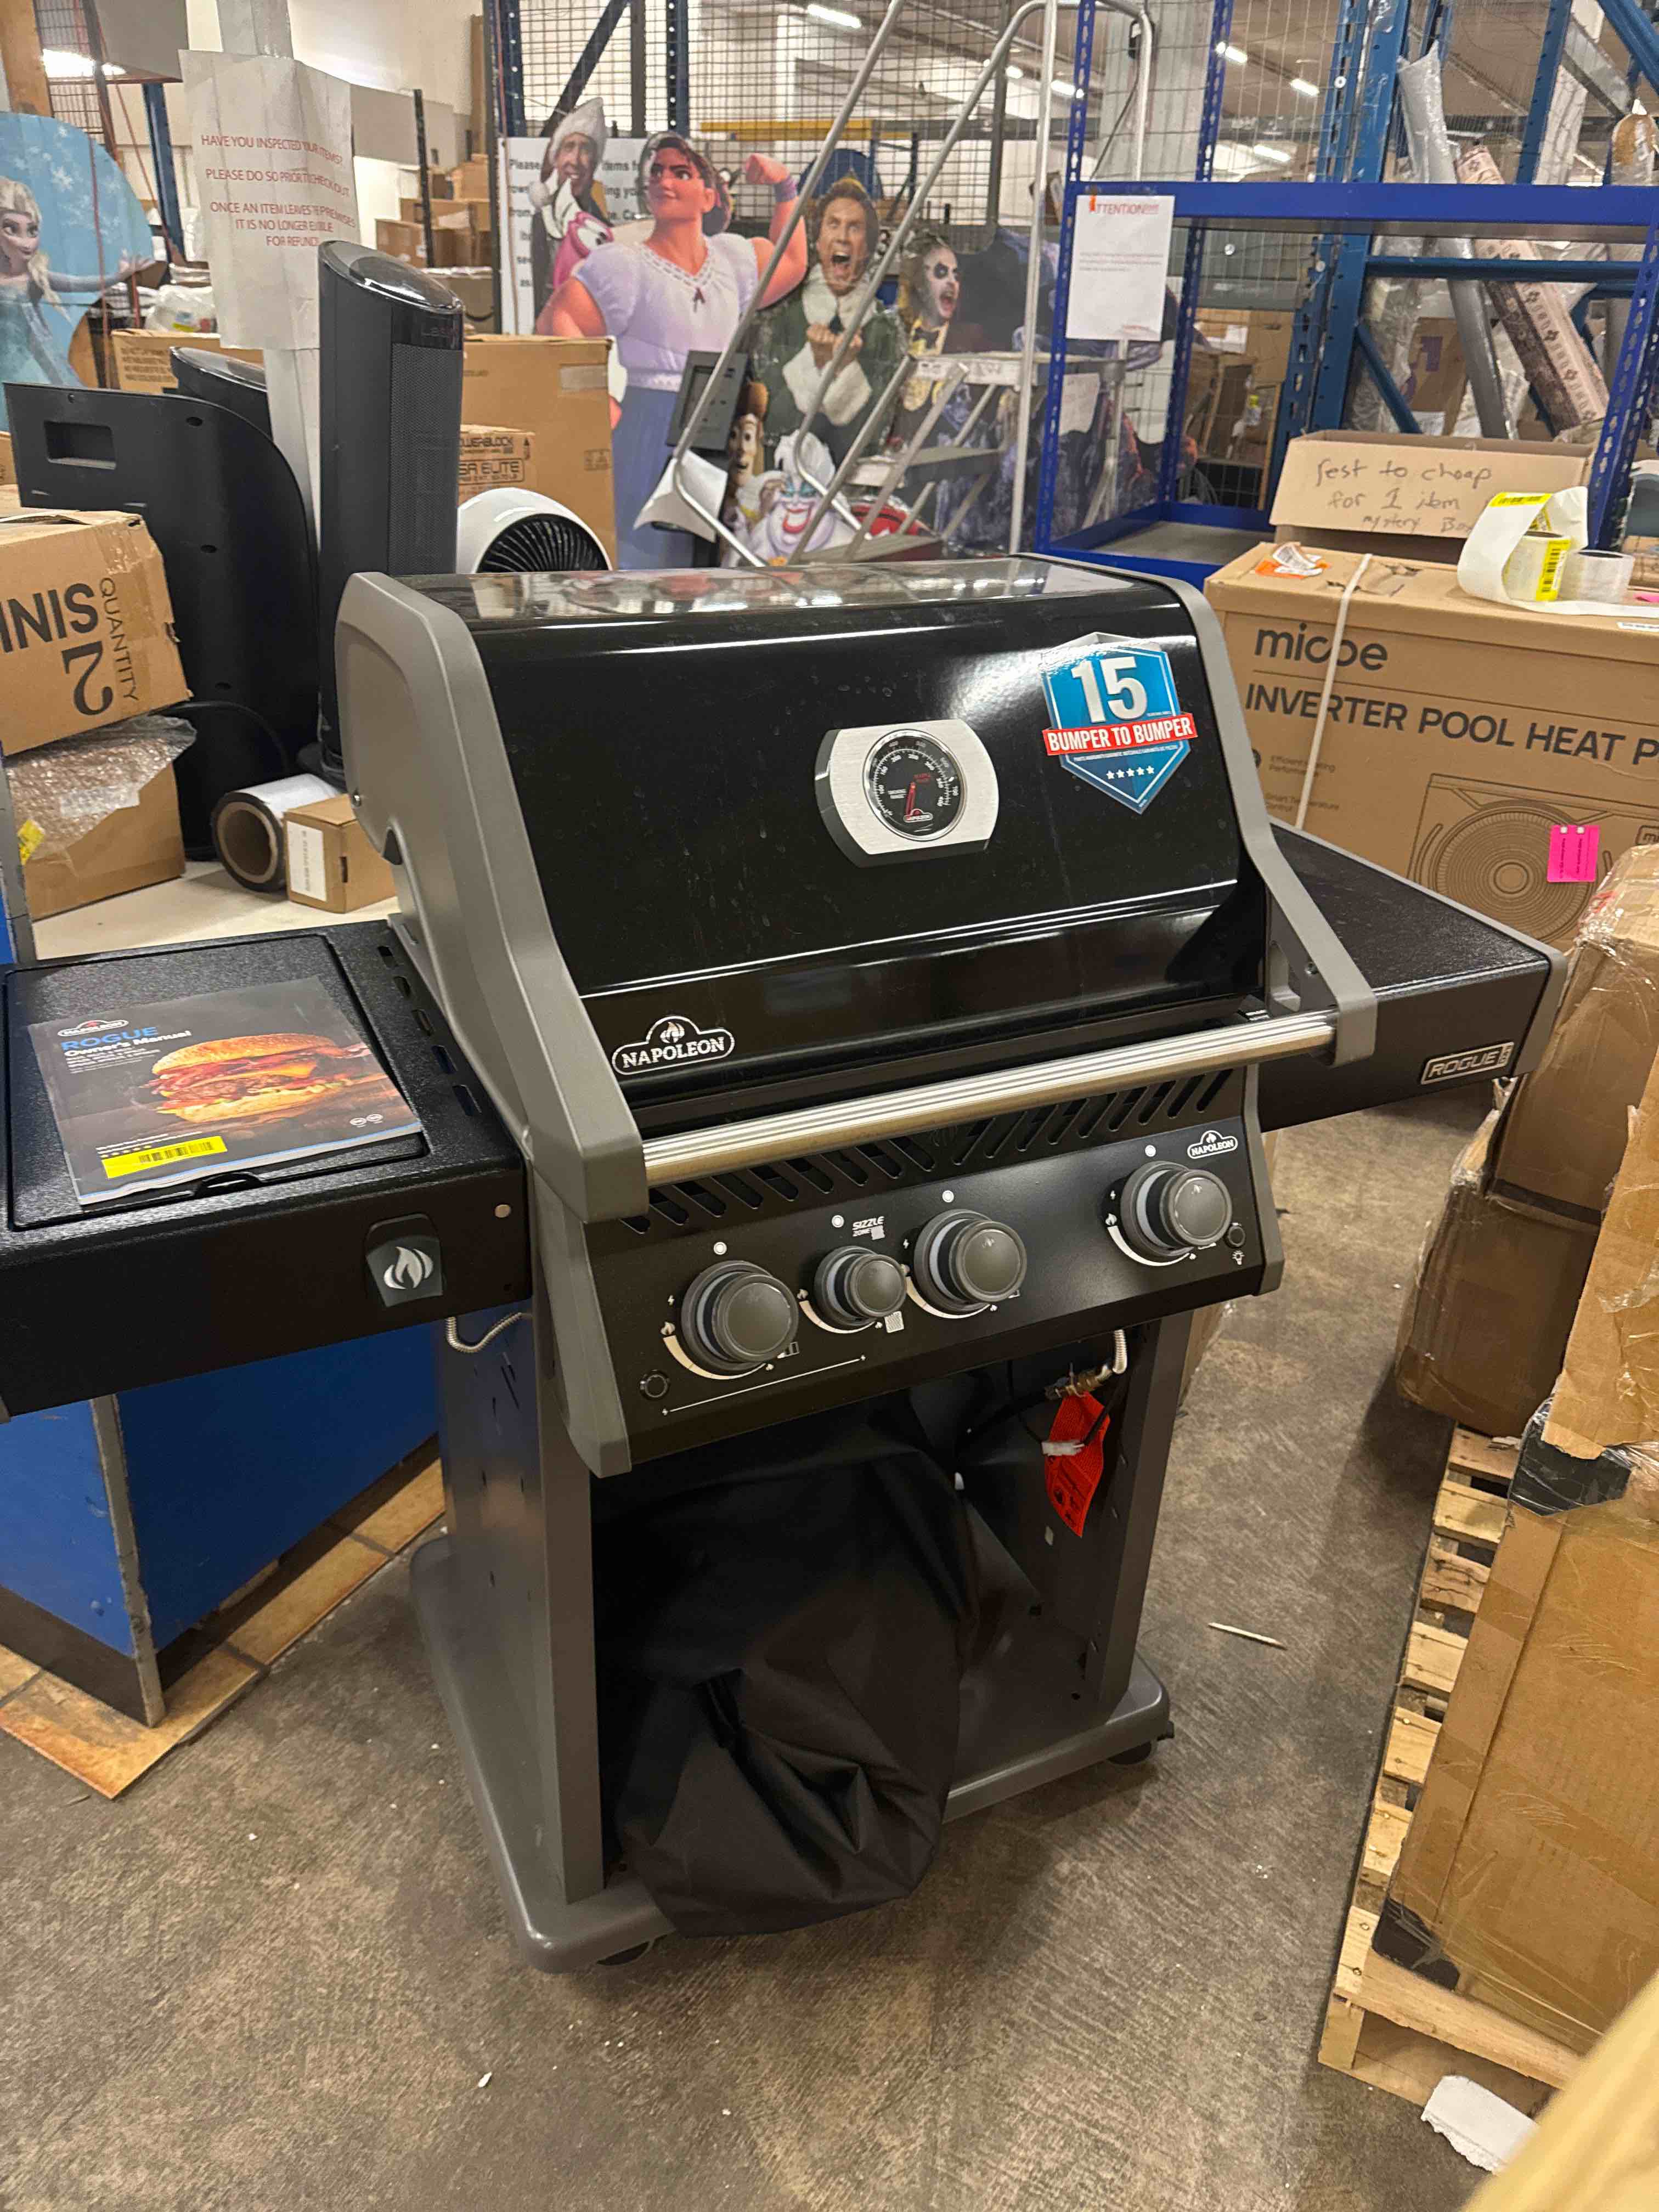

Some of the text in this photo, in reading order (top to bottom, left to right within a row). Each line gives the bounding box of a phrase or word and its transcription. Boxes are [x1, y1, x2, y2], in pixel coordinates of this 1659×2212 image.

[201, 135, 230, 146] HAVE
[231, 136, 255, 148] YOU
[206, 169, 244, 180] PLEASE
[246, 170, 263, 181] DO
[266, 171, 279, 182] SO
[210, 201, 240, 212] ONCE
[242, 202, 258, 213] AN
[260, 203, 283, 215] ITEM
[236, 219, 245, 229] IT
[246, 219, 257, 229] IS
[258, 220, 275, 230] NO
[266, 236, 285, 246] FOR
[1379, 460, 1408, 479] to
[1327, 490, 1365, 509] for
[99, 577, 139, 702] QUANTITY
[61, 640, 113, 715] 2
[1070, 656, 1148, 723] 15
[1245, 683, 1408, 731] INVERTER
[1418, 707, 1515, 747] POOL
[1525, 722, 1627, 761] HEAT
[1047, 717, 1193, 752] BUMPER TO BUMPER
[60, 1026, 159, 1052] ROGUE
[132, 1030, 192, 1045] Manual
[622, 1036, 725, 1069] NAPOLEON
[1427, 1050, 1500, 1078] ROGUE
[1190, 1139, 1235, 1156] NAPOLEON
[852, 1216, 884, 1231] SIZZLE
